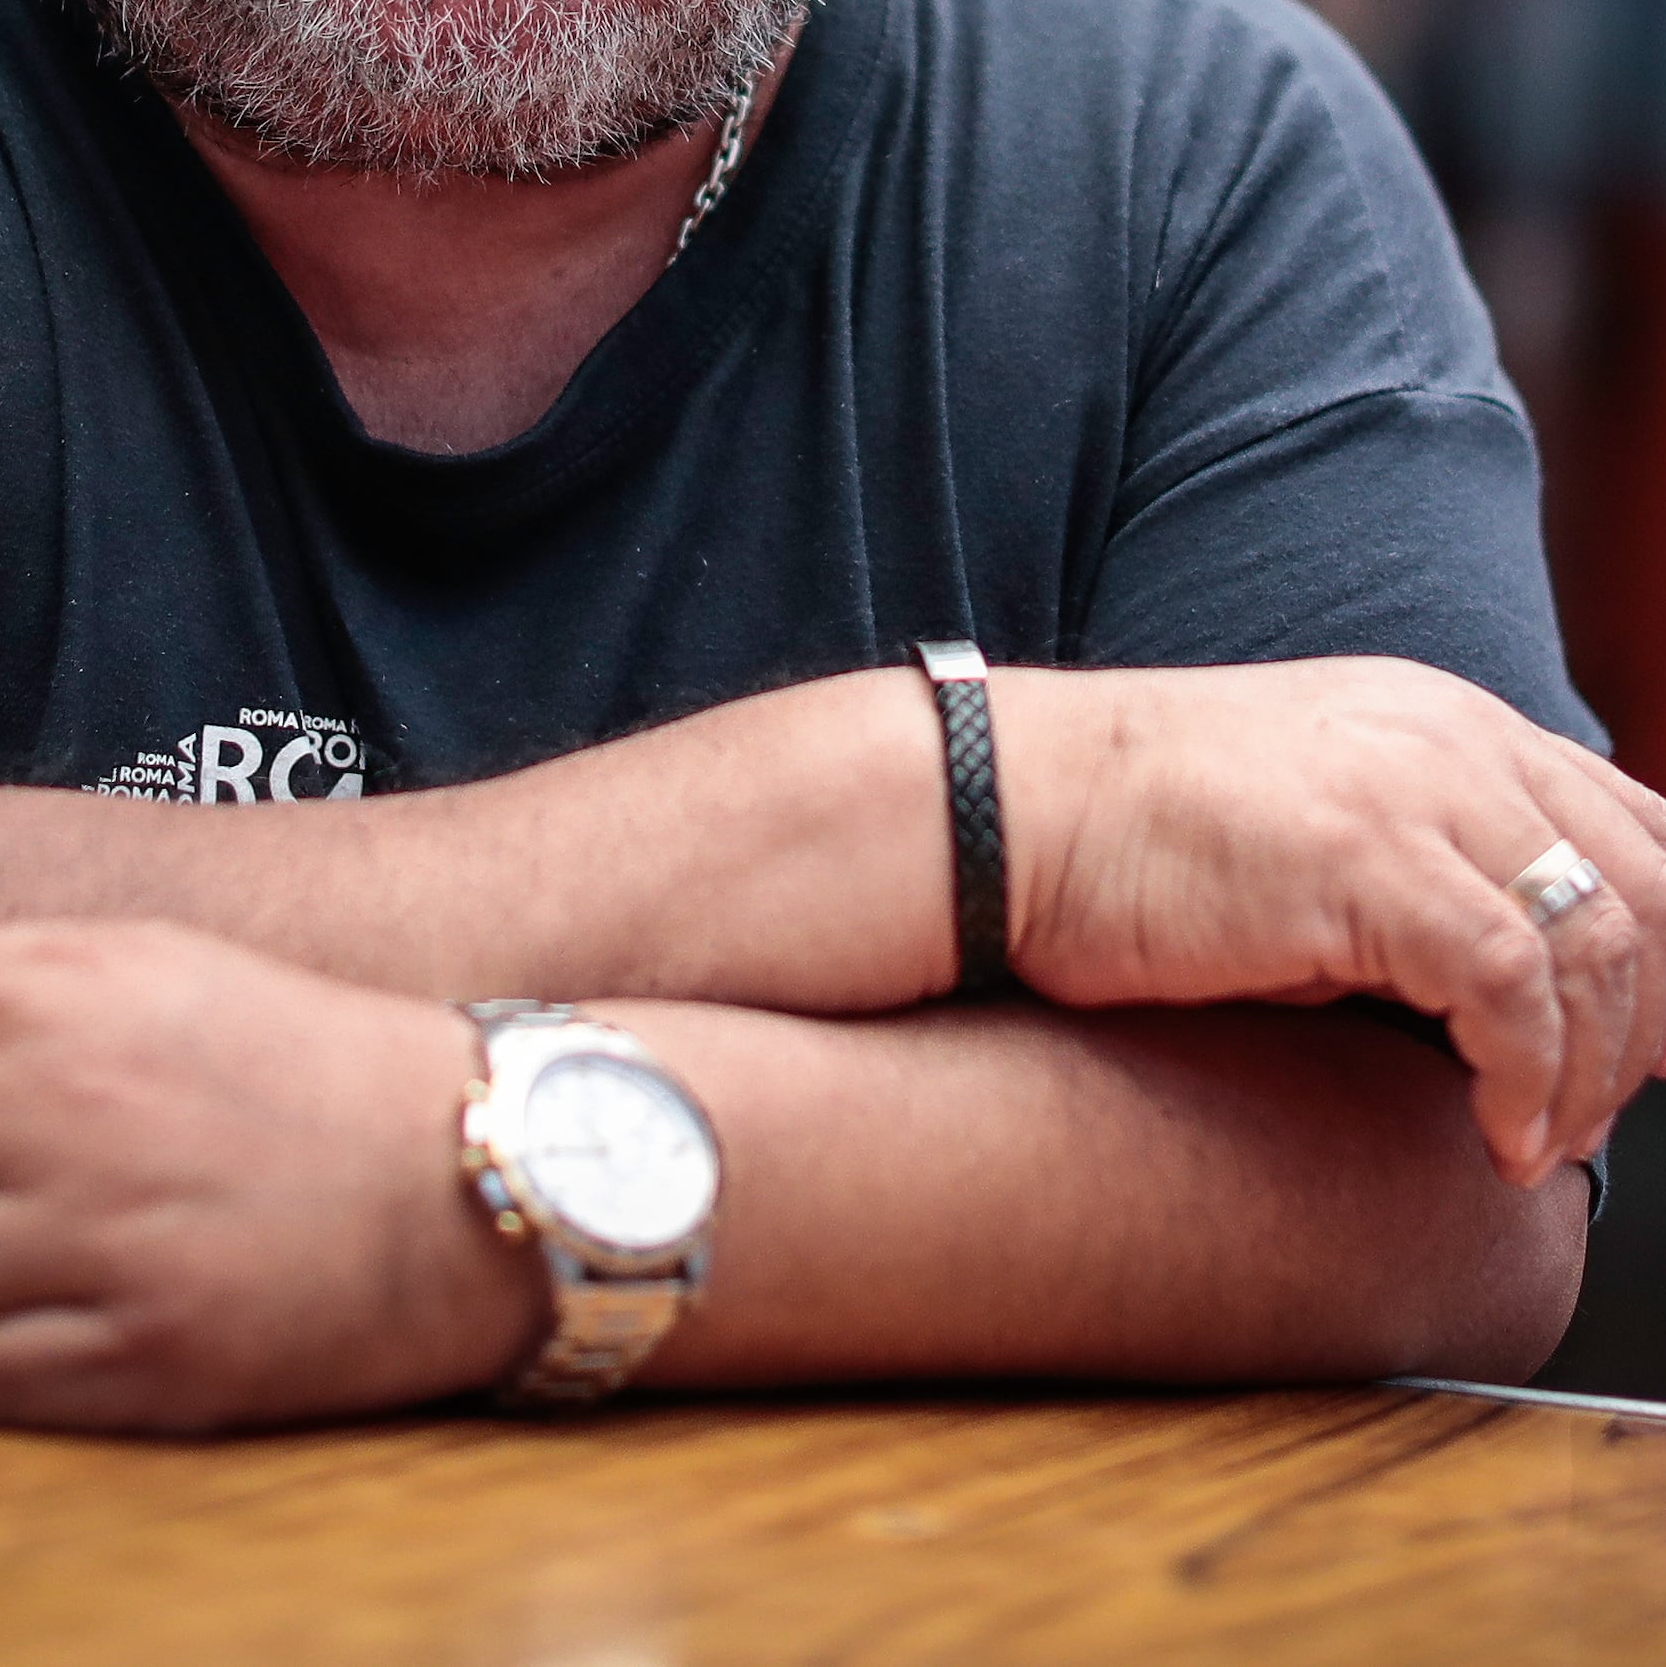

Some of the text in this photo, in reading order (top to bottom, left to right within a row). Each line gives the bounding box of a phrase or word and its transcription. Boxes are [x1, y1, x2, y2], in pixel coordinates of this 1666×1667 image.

[239, 707, 299, 730] ROMA
[303, 715, 347, 733] ROMA
[137, 752, 176, 767] ROMA
[119, 766, 175, 785] ROMA
